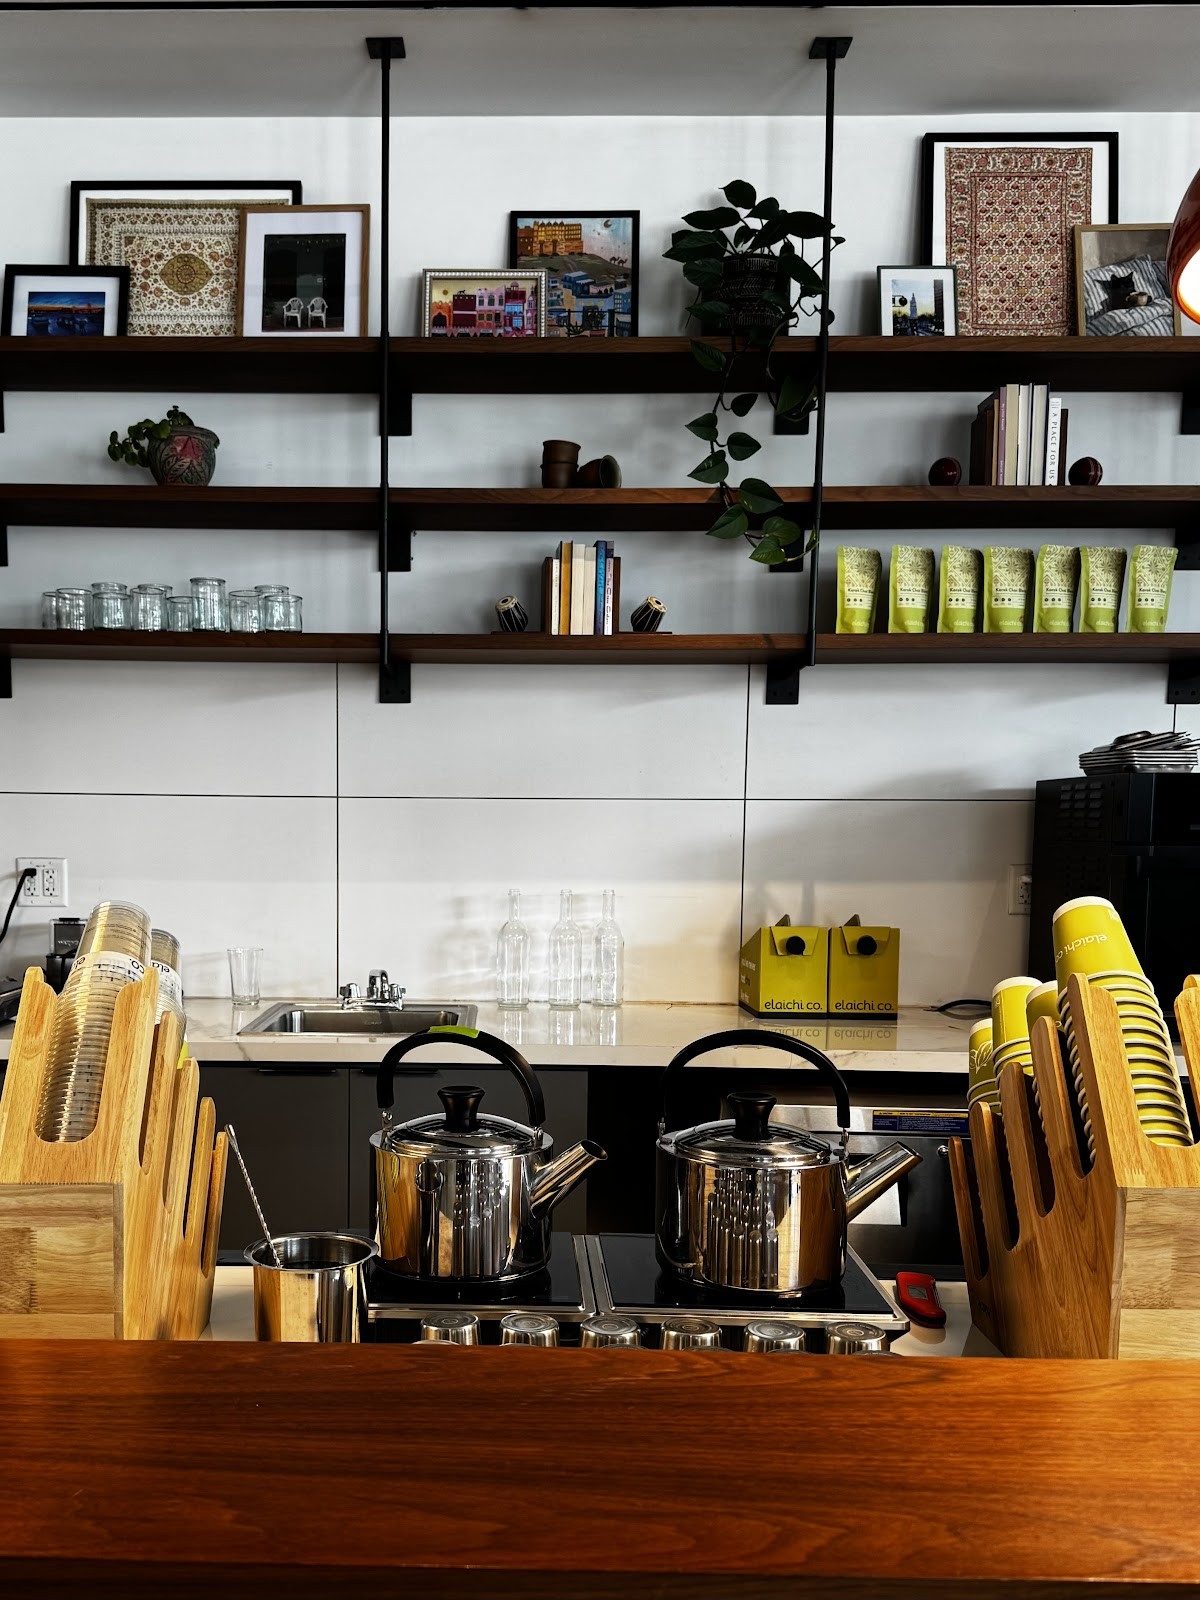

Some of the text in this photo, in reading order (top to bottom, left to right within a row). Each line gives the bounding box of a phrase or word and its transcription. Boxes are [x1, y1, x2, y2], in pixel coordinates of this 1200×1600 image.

[1050, 421, 1058, 446] PLACE
[1048, 469, 1055, 480] US
[1063, 934, 1108, 955] elaichi
[764, 998, 823, 1010] elaichi co.
[834, 1000, 894, 1011] elaichi co.
